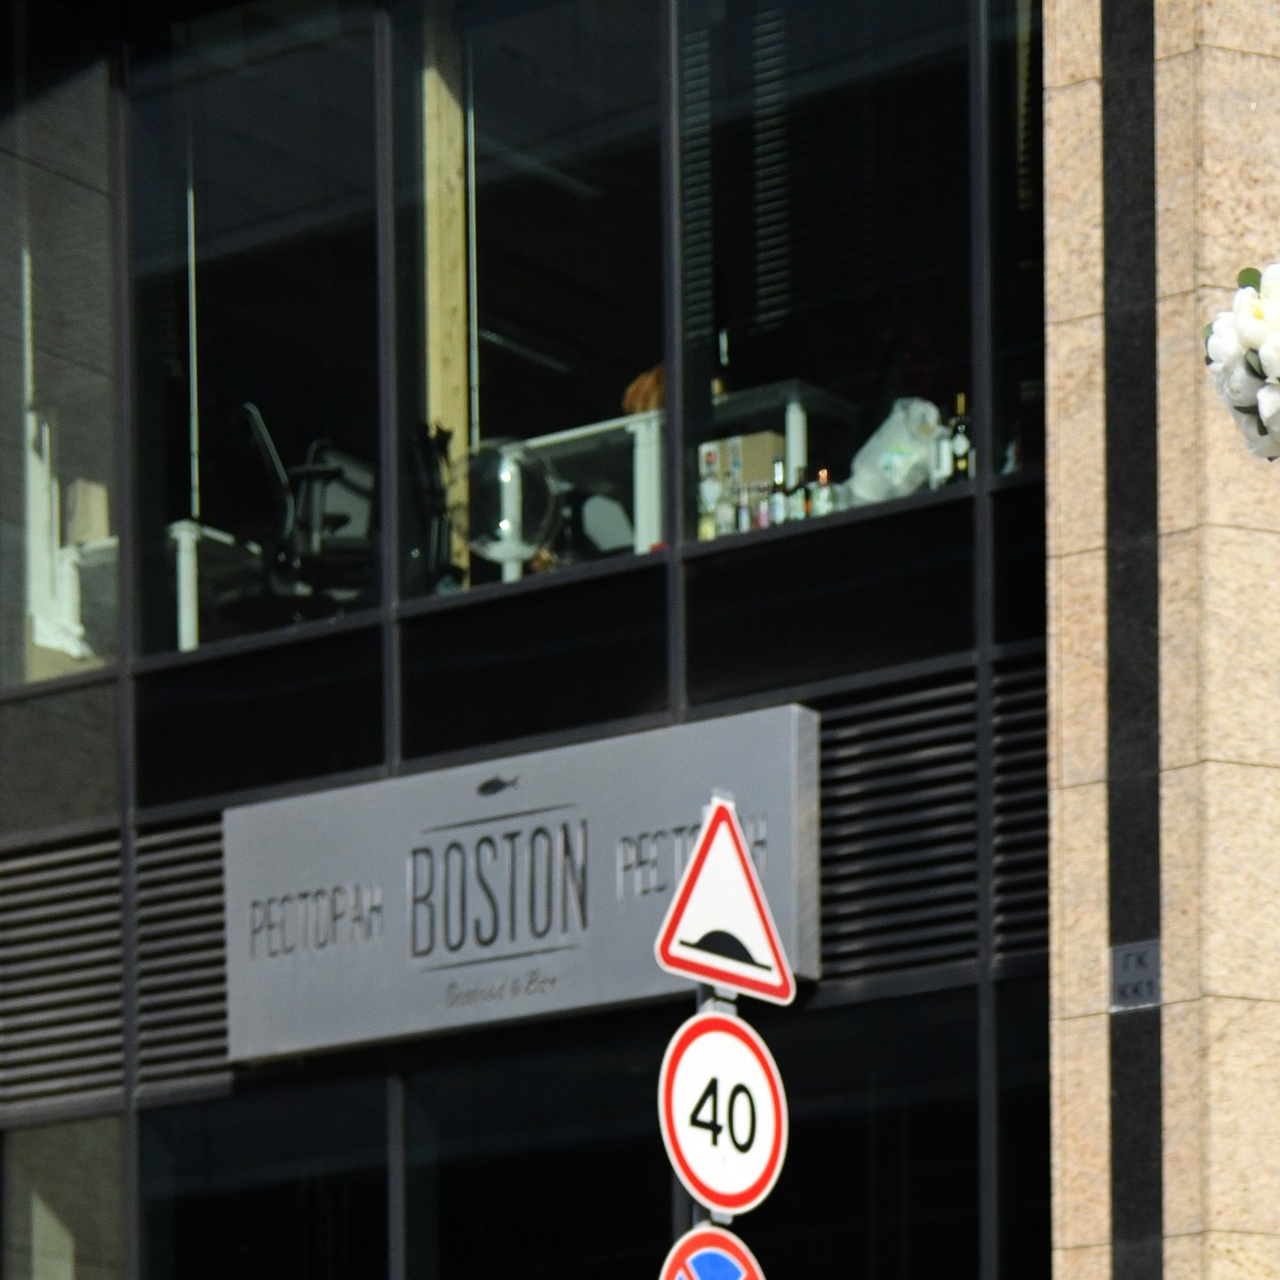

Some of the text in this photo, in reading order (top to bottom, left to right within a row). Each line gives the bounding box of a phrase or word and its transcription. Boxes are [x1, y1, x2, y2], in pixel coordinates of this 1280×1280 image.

[251, 882, 385, 958] РЕСТОРАН
[410, 819, 588, 958] BOSTON
[690, 1076, 756, 1154] 40
